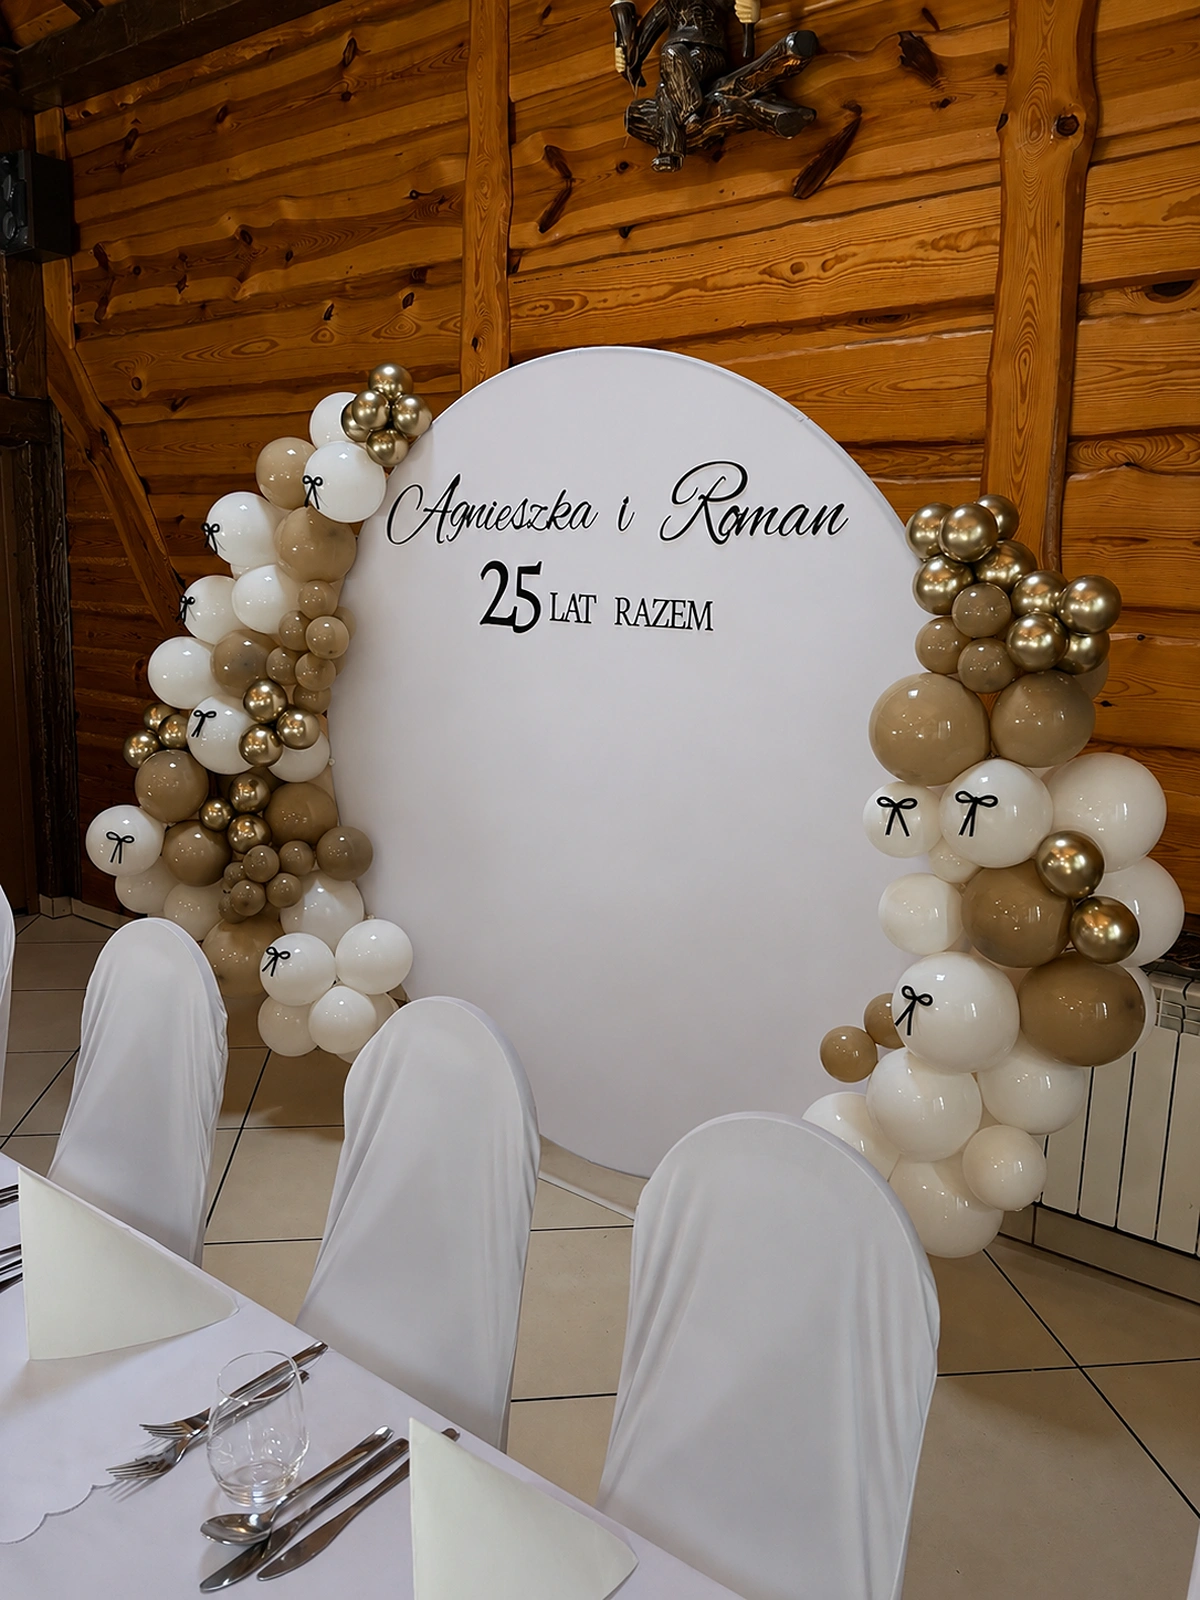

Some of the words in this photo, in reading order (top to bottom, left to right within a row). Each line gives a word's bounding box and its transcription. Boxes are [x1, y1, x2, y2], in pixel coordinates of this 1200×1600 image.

[386, 473, 598, 545] Agnieszka
[617, 495, 635, 532] i
[659, 460, 849, 545] Roman
[479, 560, 543, 633] 25
[549, 591, 597, 624] LAT
[614, 596, 714, 631] RAZEM
